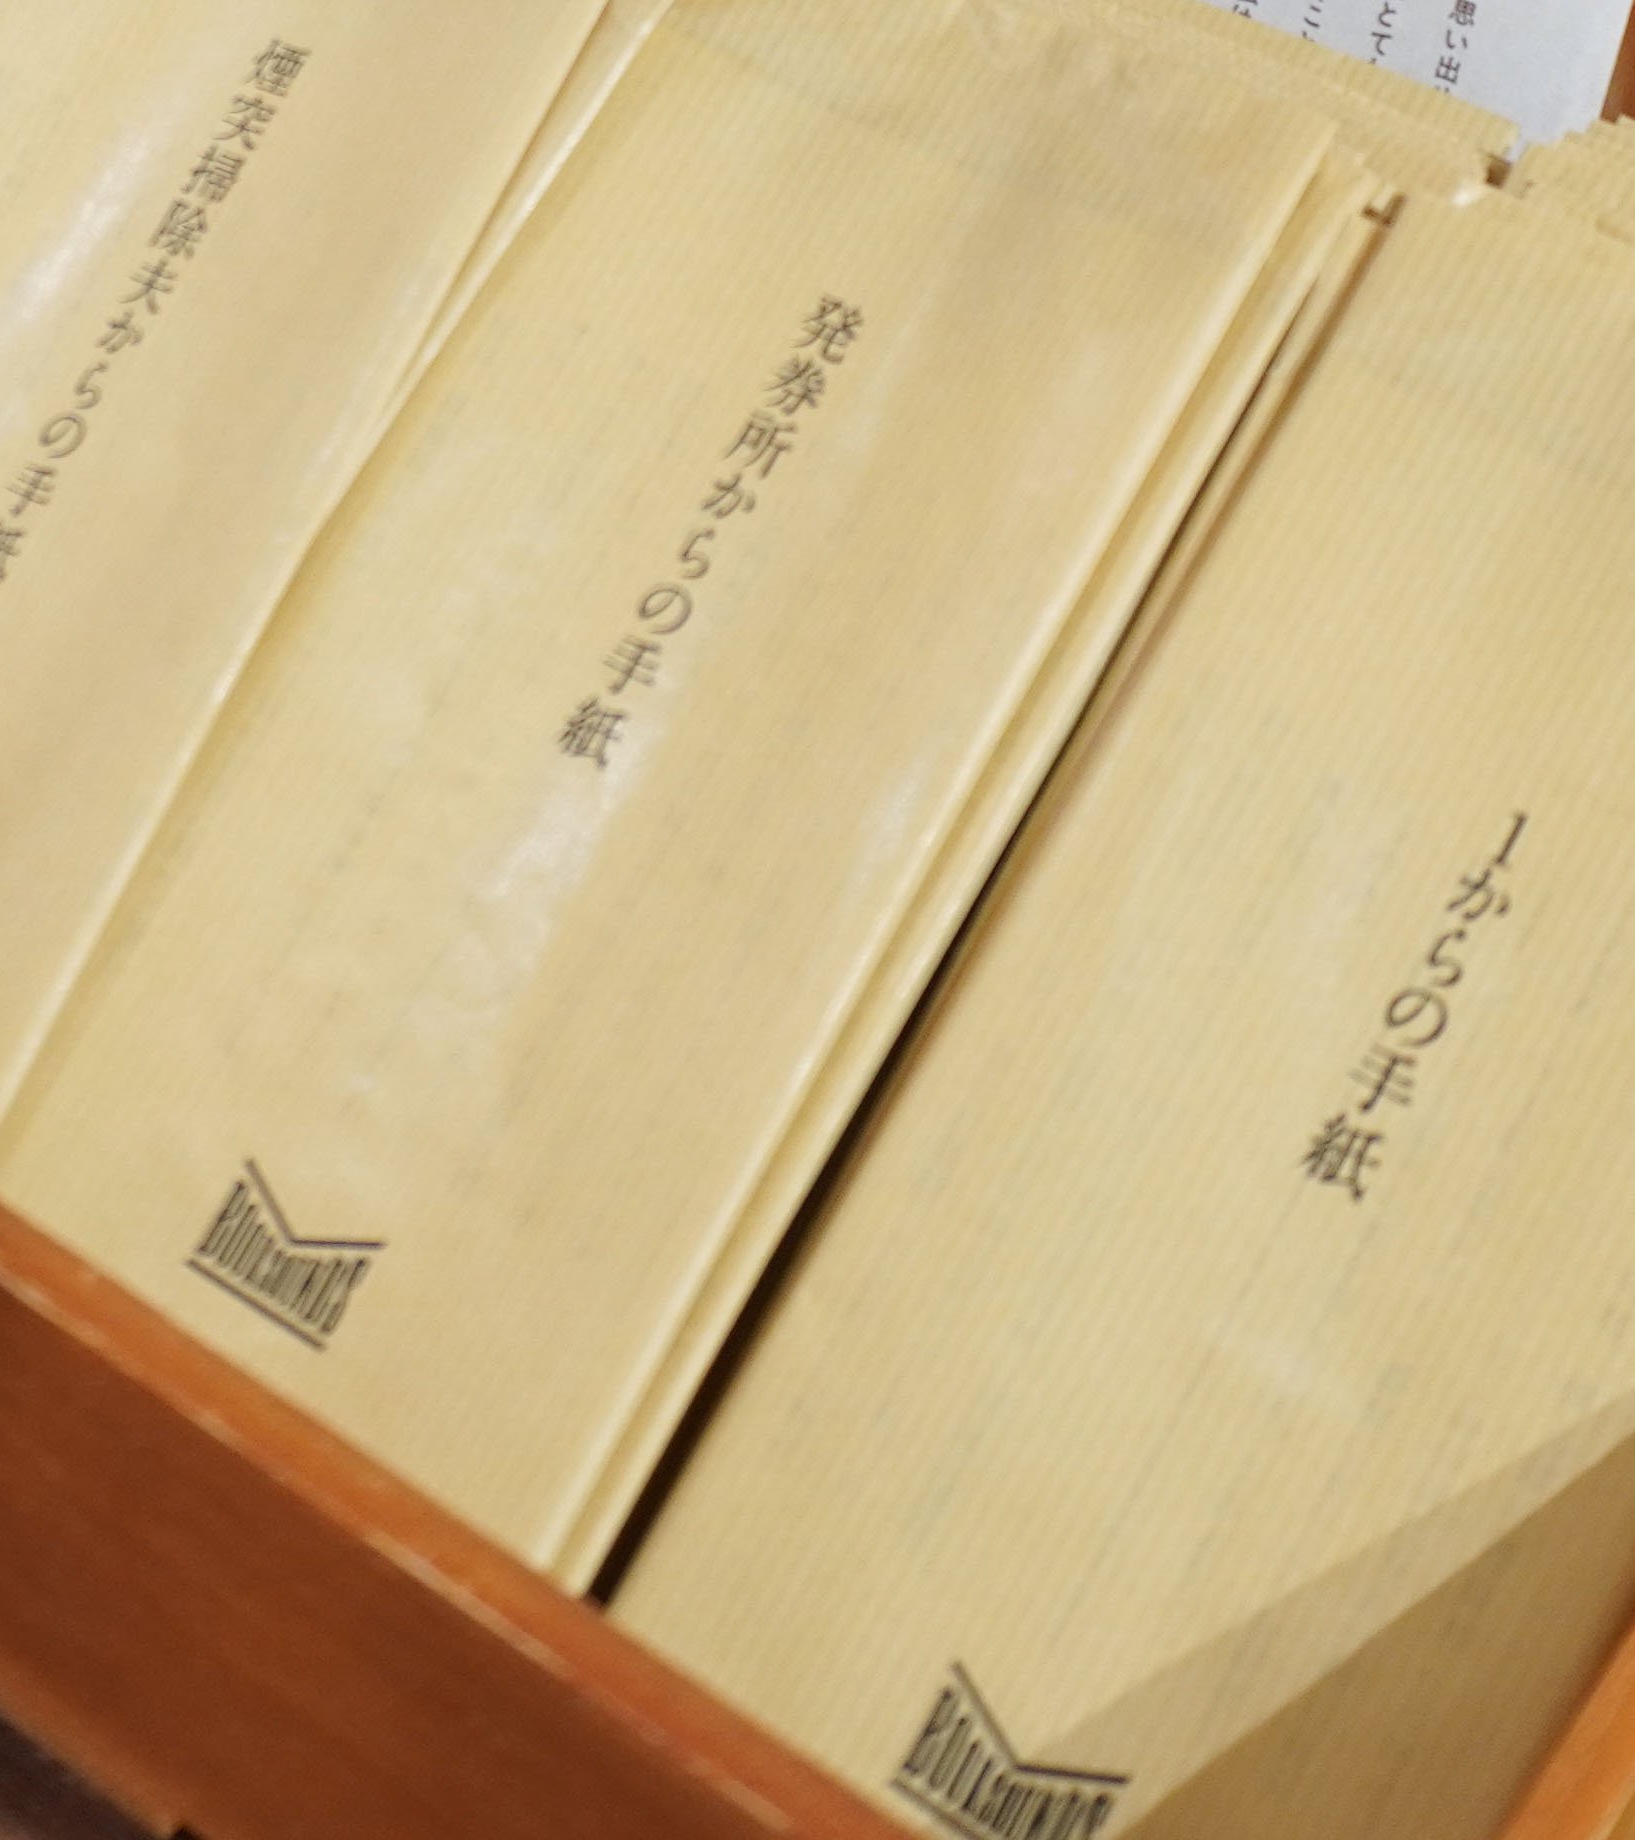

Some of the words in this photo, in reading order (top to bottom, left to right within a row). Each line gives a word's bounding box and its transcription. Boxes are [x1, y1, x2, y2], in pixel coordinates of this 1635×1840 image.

[557, 291, 865, 772] 発券所からの手紙
